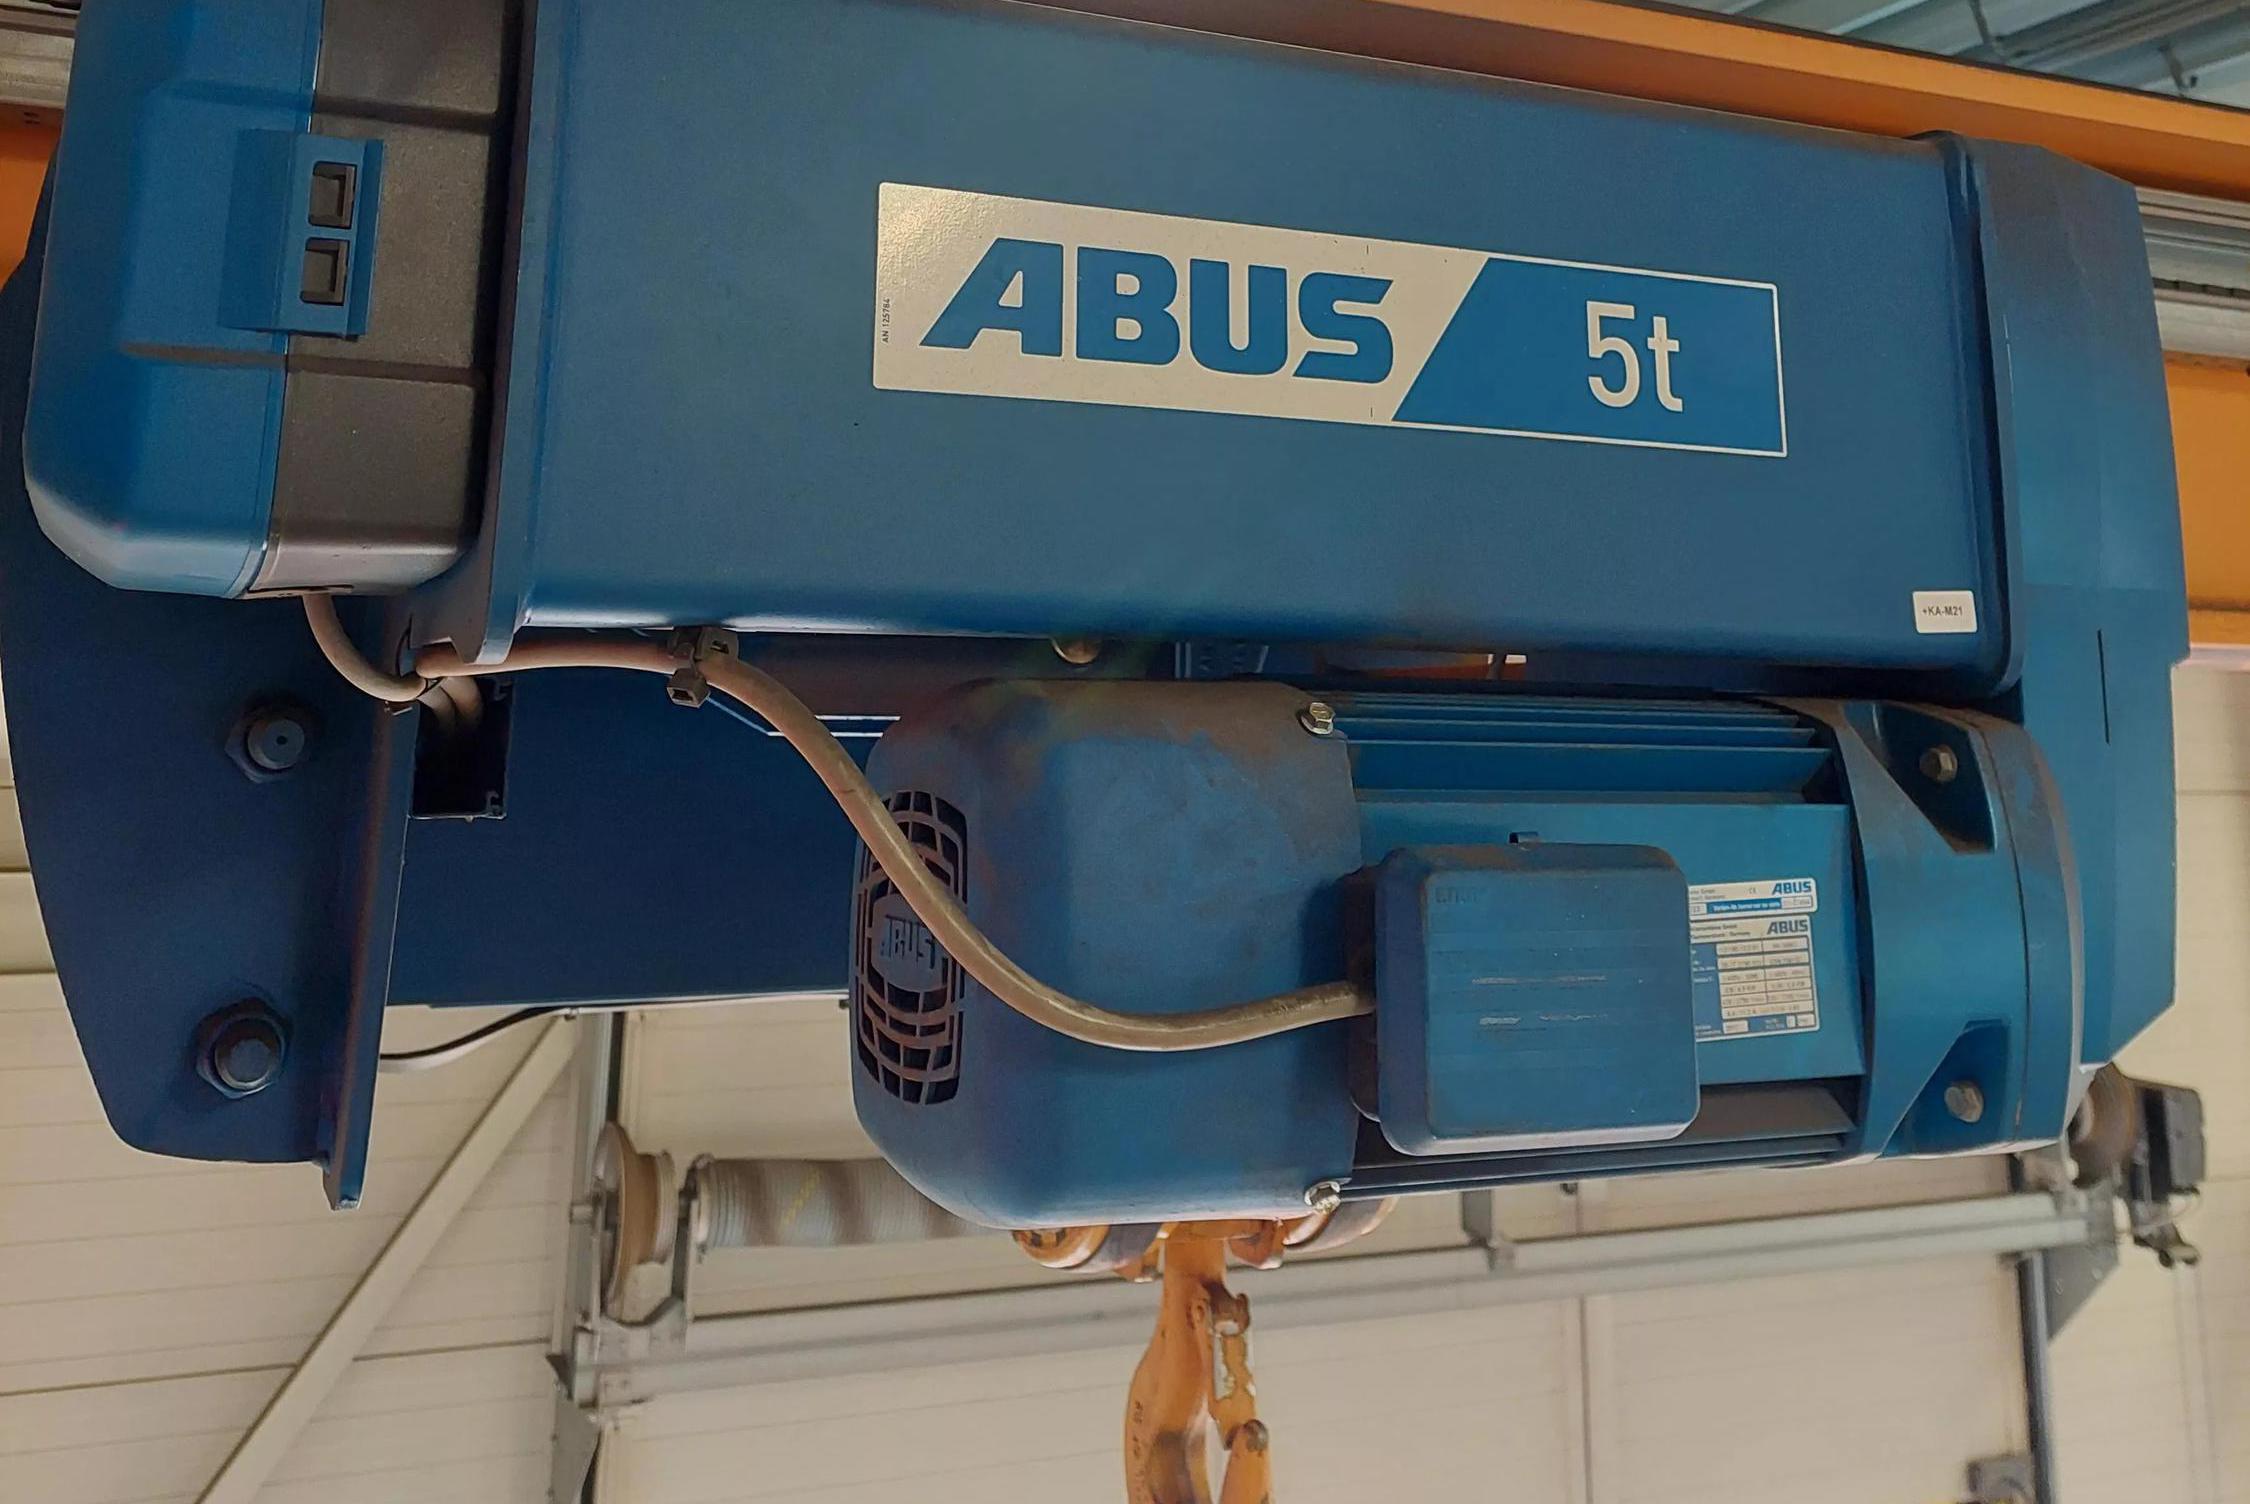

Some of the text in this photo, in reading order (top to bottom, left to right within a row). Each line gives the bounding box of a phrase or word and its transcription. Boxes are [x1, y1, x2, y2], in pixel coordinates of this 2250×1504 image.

[919, 237, 1394, 384] ABUS
[881, 331, 889, 343] AN
[1586, 299, 1685, 413] 5t
[1922, 605, 1963, 617] +KA-M21
[1772, 881, 1812, 896] ABUS
[1767, 919, 1809, 935] ABUS
